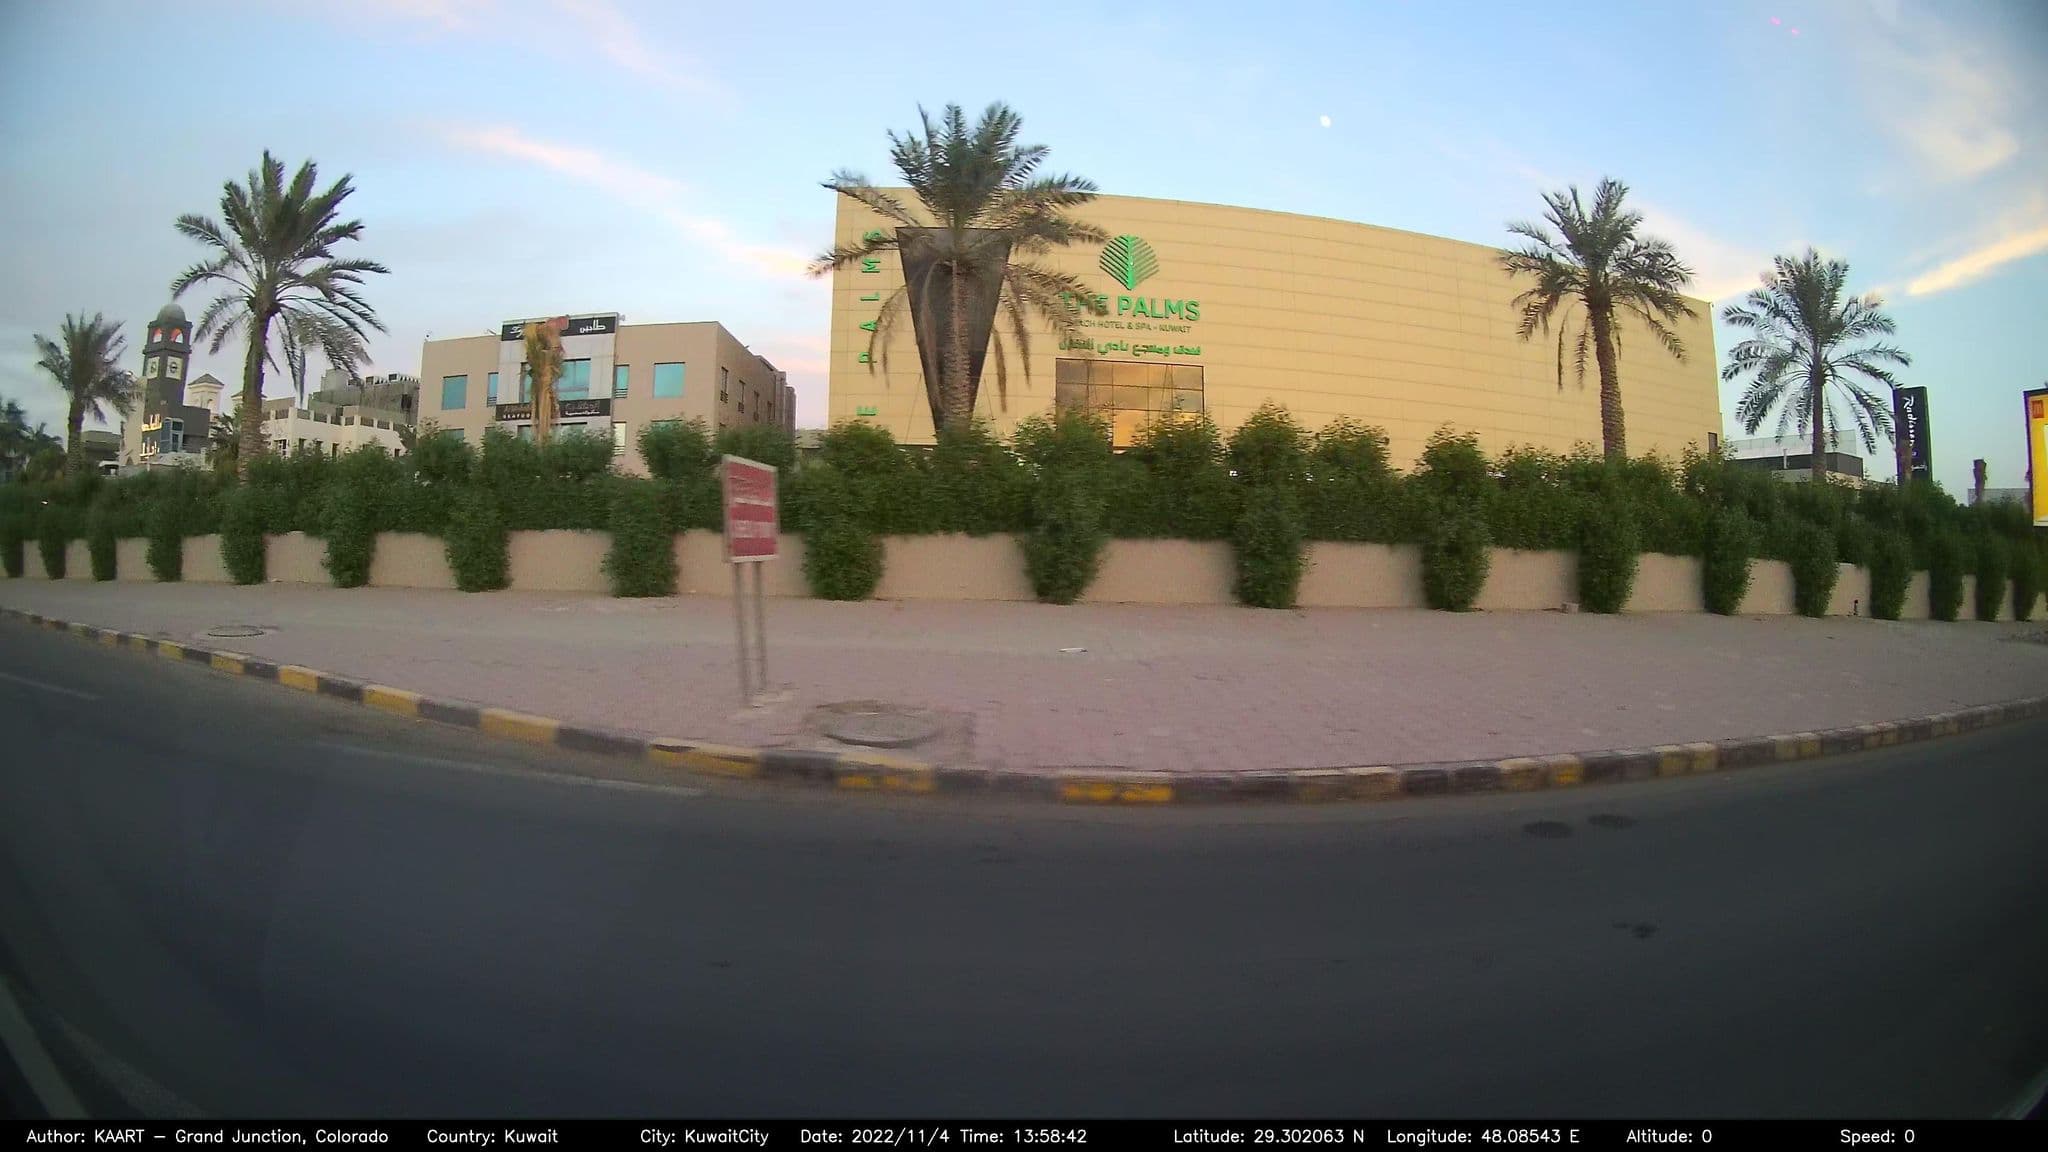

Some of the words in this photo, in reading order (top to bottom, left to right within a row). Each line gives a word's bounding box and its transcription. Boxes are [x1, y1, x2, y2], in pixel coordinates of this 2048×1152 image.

[1117, 295, 1201, 321] PALMS
[1098, 321, 1125, 330] HOTEL
[1135, 322, 1152, 331] SPA
[1159, 324, 1192, 333] KUWAIT
[1902, 395, 1917, 446] Radisson
